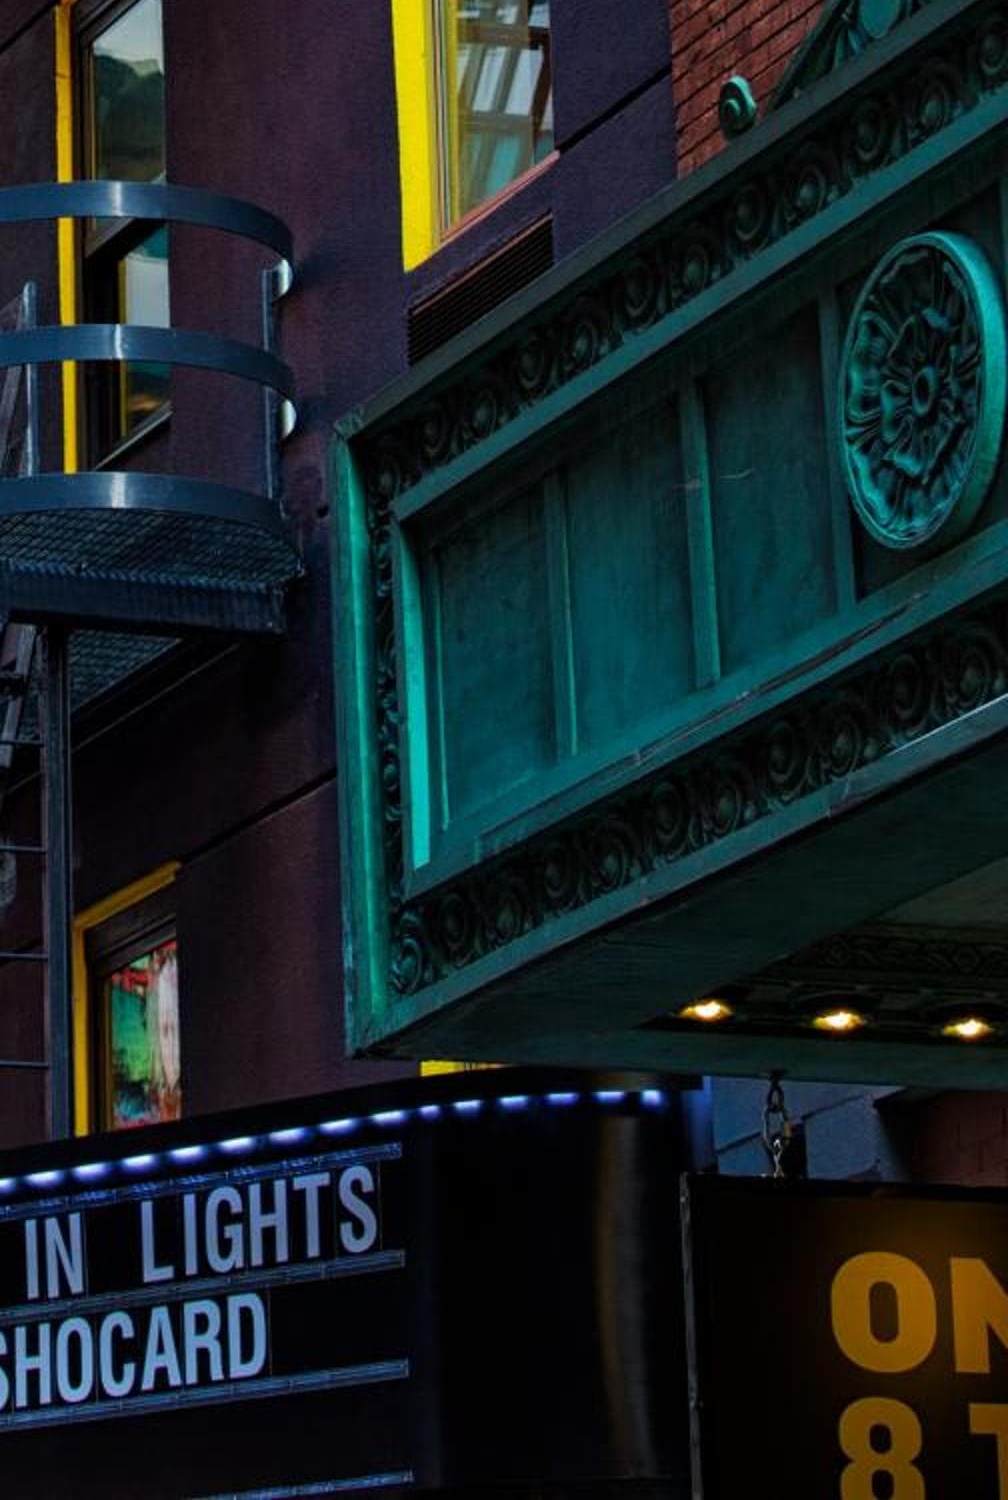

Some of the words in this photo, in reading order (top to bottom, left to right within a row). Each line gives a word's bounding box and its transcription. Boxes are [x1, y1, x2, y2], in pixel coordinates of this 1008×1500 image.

[24, 1212, 86, 1299] IN
[141, 1165, 378, 1283] LIGHTS
[838, 1396, 926, 1500] 8
